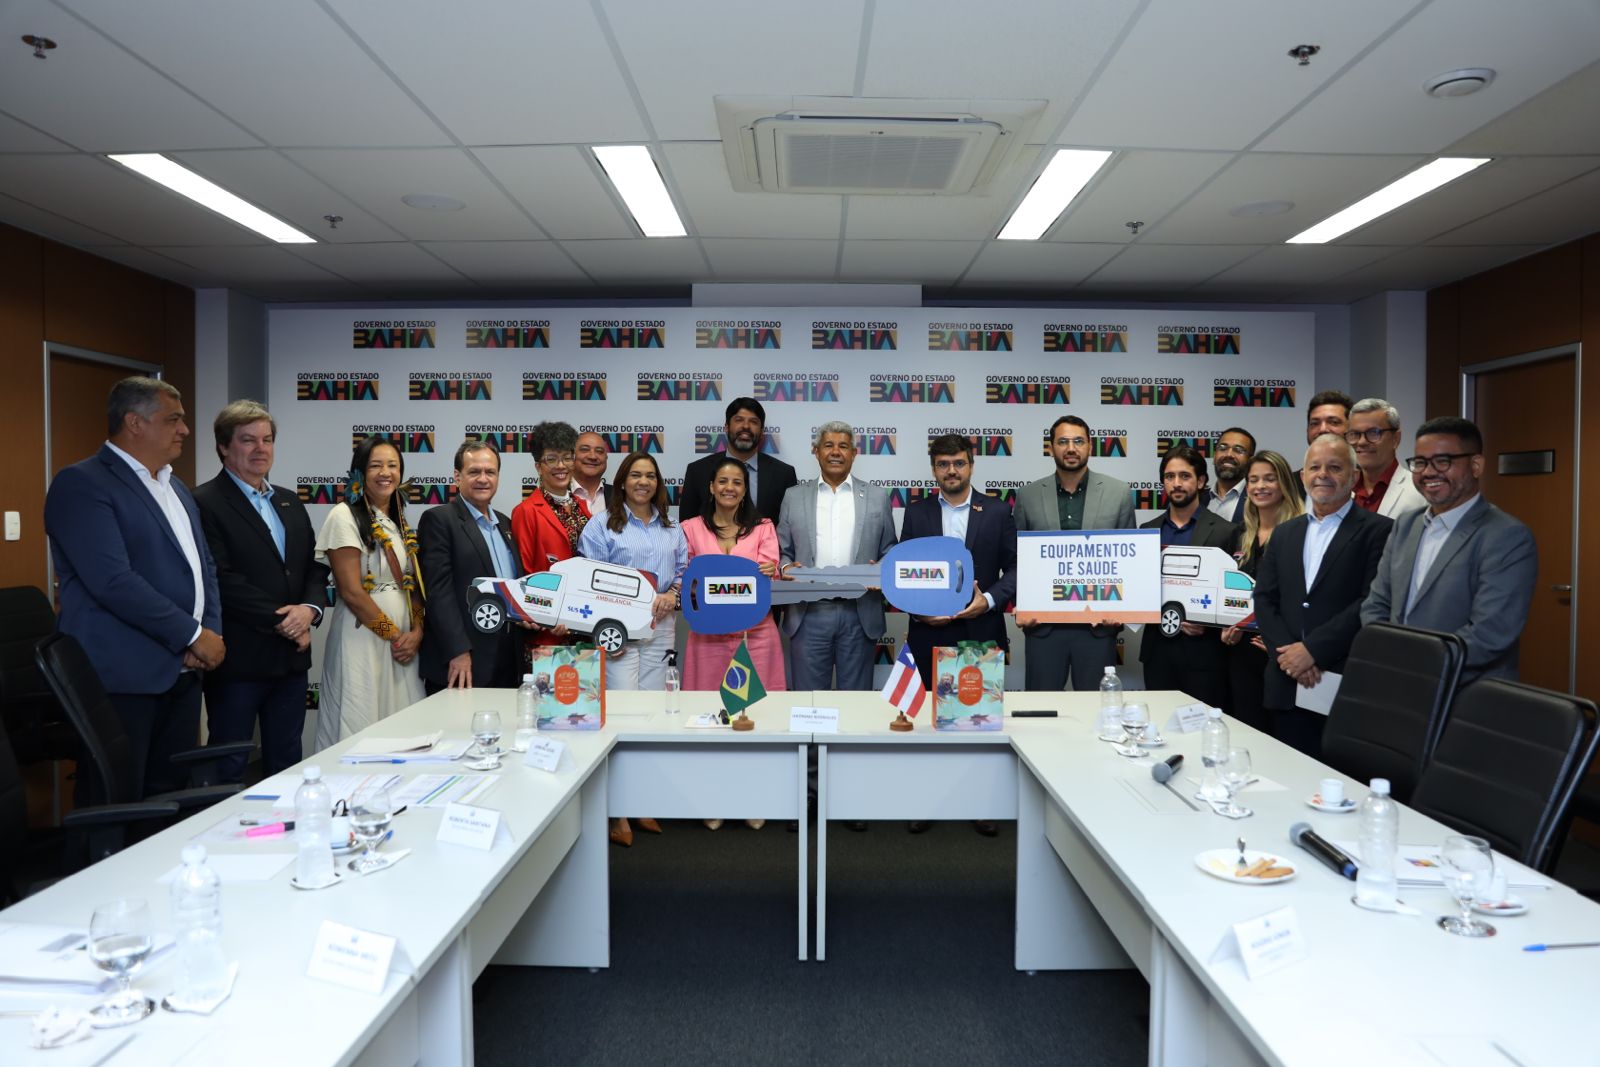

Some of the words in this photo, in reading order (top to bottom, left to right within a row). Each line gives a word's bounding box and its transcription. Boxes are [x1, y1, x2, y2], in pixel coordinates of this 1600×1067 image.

[354, 320, 391, 328] GOVERNO
[393, 320, 405, 328] DO
[407, 320, 435, 328] ESTADO
[466, 320, 505, 328] GOVERNO
[507, 320, 518, 328] DO
[520, 320, 550, 328] ESTADO
[580, 320, 620, 328] GOVERNO
[622, 320, 633, 328] DO
[635, 320, 665, 328] ESTADO
[696, 321, 735, 329] GOVERNO
[737, 321, 749, 329] DO
[751, 321, 781, 329] ESTADO
[812, 322, 851, 330] GOVERNO
[853, 322, 865, 330] DO
[867, 322, 897, 330] ESTADO
[928, 323, 968, 331] GOVERNO
[970, 323, 981, 331] DO
[983, 323, 1013, 331] ESTADO
[1044, 324, 1082, 332] GOVERNO
[1084, 324, 1096, 332] DO
[1098, 324, 1128, 332] ESTADO
[1158, 326, 1196, 334] GOVERNO
[1198, 326, 1209, 334] DO
[1211, 326, 1240, 334] ESTADO
[354, 329, 435, 348] BAHIA
[466, 328, 550, 348] BAHIA
[580, 328, 665, 348] BAHIA
[696, 329, 781, 348] BAHIA
[812, 330, 897, 350] BAHIA
[928, 331, 1013, 351] BAHIA
[1044, 332, 1128, 352] BAHIA
[1158, 334, 1240, 354] BAHIA
[297, 372, 335, 380] GOVERNO
[337, 372, 348, 380] DO
[350, 372, 379, 380] ESTADO
[409, 372, 447, 380] GOVERNO
[449, 372, 461, 380] DO
[463, 372, 492, 380] ESTADO
[523, 372, 561, 380] GOVERNO
[563, 372, 575, 380] DO
[577, 372, 606, 380] ESTADO
[638, 373, 677, 381] GOVERNO
[679, 373, 690, 381] DO
[692, 373, 722, 381] ESTADO
[754, 374, 793, 382] GOVERNO
[795, 374, 807, 382] DO
[809, 374, 839, 382] ESTADO
[870, 375, 909, 383] GOVERNO
[911, 375, 923, 383] DO
[925, 375, 955, 383] ESTADO
[986, 376, 1025, 384] GOVERNO
[1027, 376, 1039, 384] DO
[1041, 376, 1070, 384] ESTADO
[1101, 377, 1139, 385] GOVERNO
[1141, 377, 1153, 385] DO
[1155, 377, 1184, 385] ESTADO
[1214, 379, 1252, 387] GOVERNO
[1254, 379, 1265, 387] DO
[1267, 379, 1295, 387] ESTADO
[297, 381, 379, 400] BAHIA
[409, 381, 492, 400] BAHIA
[523, 381, 606, 400] BAHIA
[638, 381, 722, 400] BAHIA
[754, 382, 839, 402] BAHIA
[870, 383, 955, 402] BAHIA
[986, 384, 1070, 404] BAHIA
[1101, 385, 1184, 405] BAHIA
[1214, 387, 1295, 407] BAHIA
[580, 425, 618, 433] GOVERNO
[621, 425, 632, 433] DO
[634, 425, 664, 433] ESTADO
[1158, 430, 1195, 438] GOVERNO
[601, 433, 664, 453] AHIA
[297, 484, 346, 504] BAH
[408, 485, 459, 504] BAH
[1040, 543, 1136, 558] EQUIPAMENTOS
[900, 568, 945, 578] BAHIA
[1058, 562, 1073, 576] DE
[1078, 560, 1118, 575] SAÚDE
[709, 584, 752, 594] BAHIA
[1053, 585, 1123, 601] BAHIA
